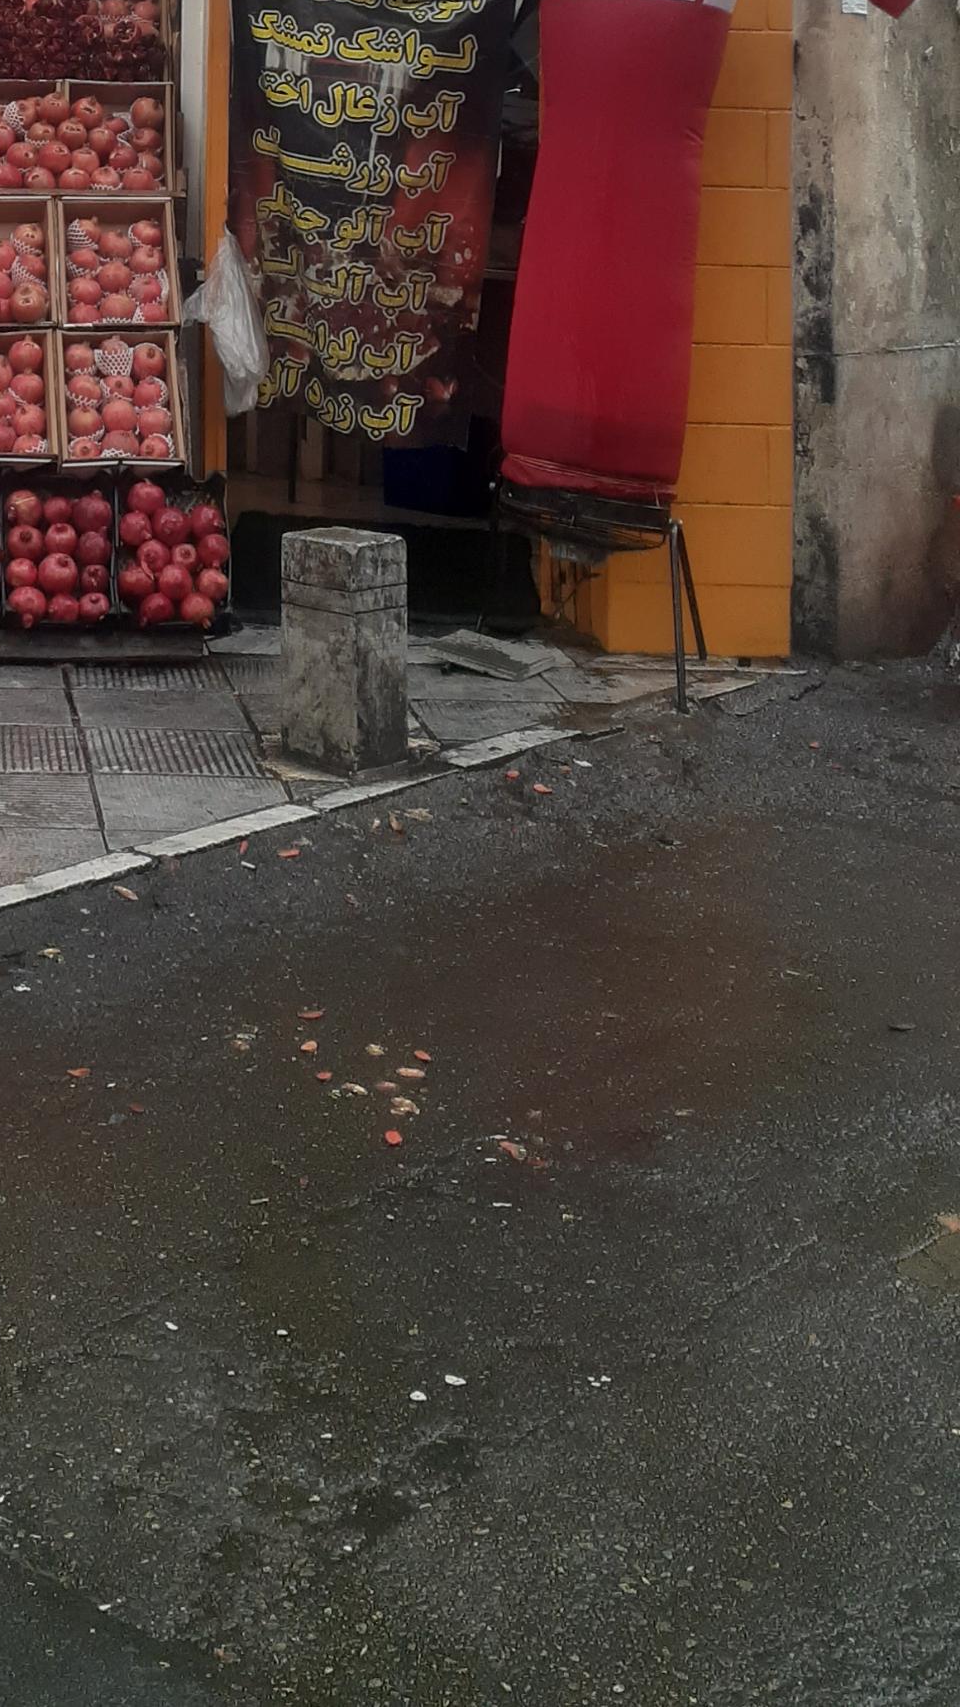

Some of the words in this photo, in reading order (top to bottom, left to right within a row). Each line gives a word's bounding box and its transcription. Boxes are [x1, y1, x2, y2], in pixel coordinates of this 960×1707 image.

[336, 26, 478, 77] لواشک
[313, 81, 399, 136] زغال
[402, 91, 465, 138] آب
[396, 151, 457, 199] آب
[329, 204, 395, 252] آلو
[392, 211, 454, 258] آب
[373, 270, 437, 318] آب
[360, 331, 425, 379] آب
[357, 392, 426, 440] آب
